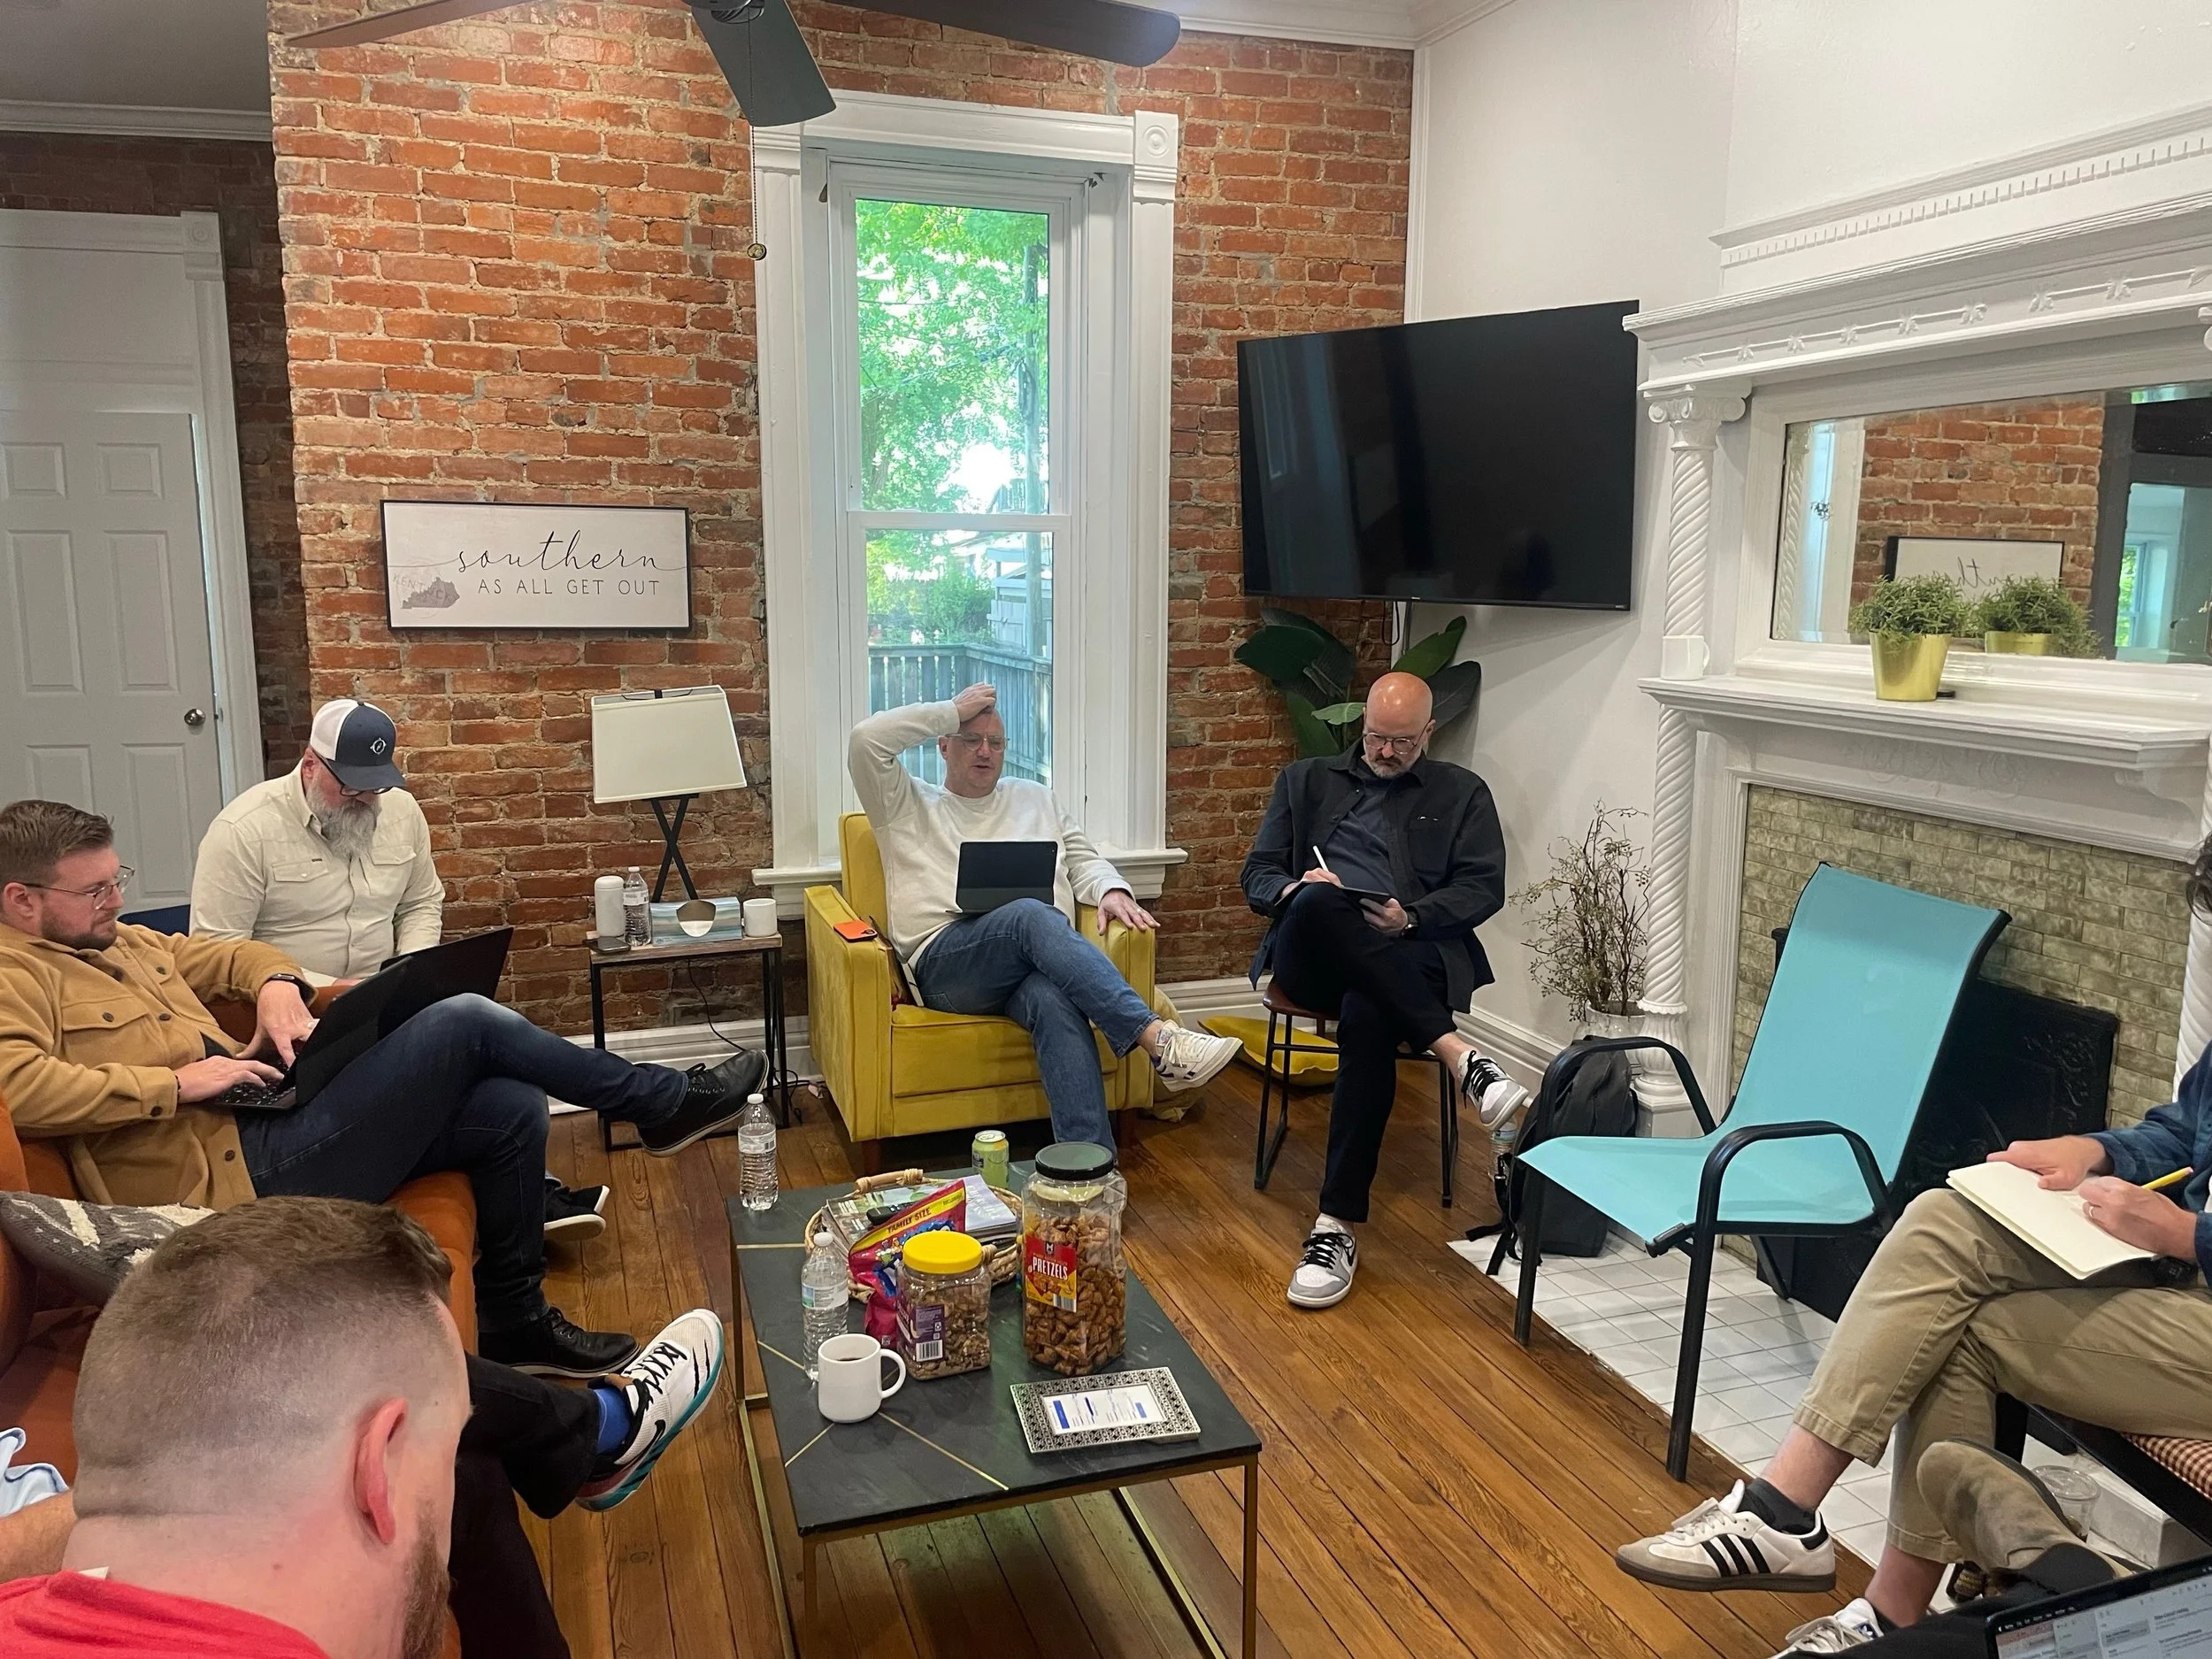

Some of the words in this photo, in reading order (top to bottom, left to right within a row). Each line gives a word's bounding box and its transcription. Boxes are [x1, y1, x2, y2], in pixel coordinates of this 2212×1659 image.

[457, 529, 663, 573] southern
[478, 579, 502, 595] AS
[516, 579, 553, 595] ALL
[566, 579, 604, 595] GET
[618, 580, 660, 595] OUT
[886, 1216, 912, 1234] FAMILY
[914, 1208, 932, 1222] SIZE
[1033, 1256, 1068, 1280] PRETZELS
